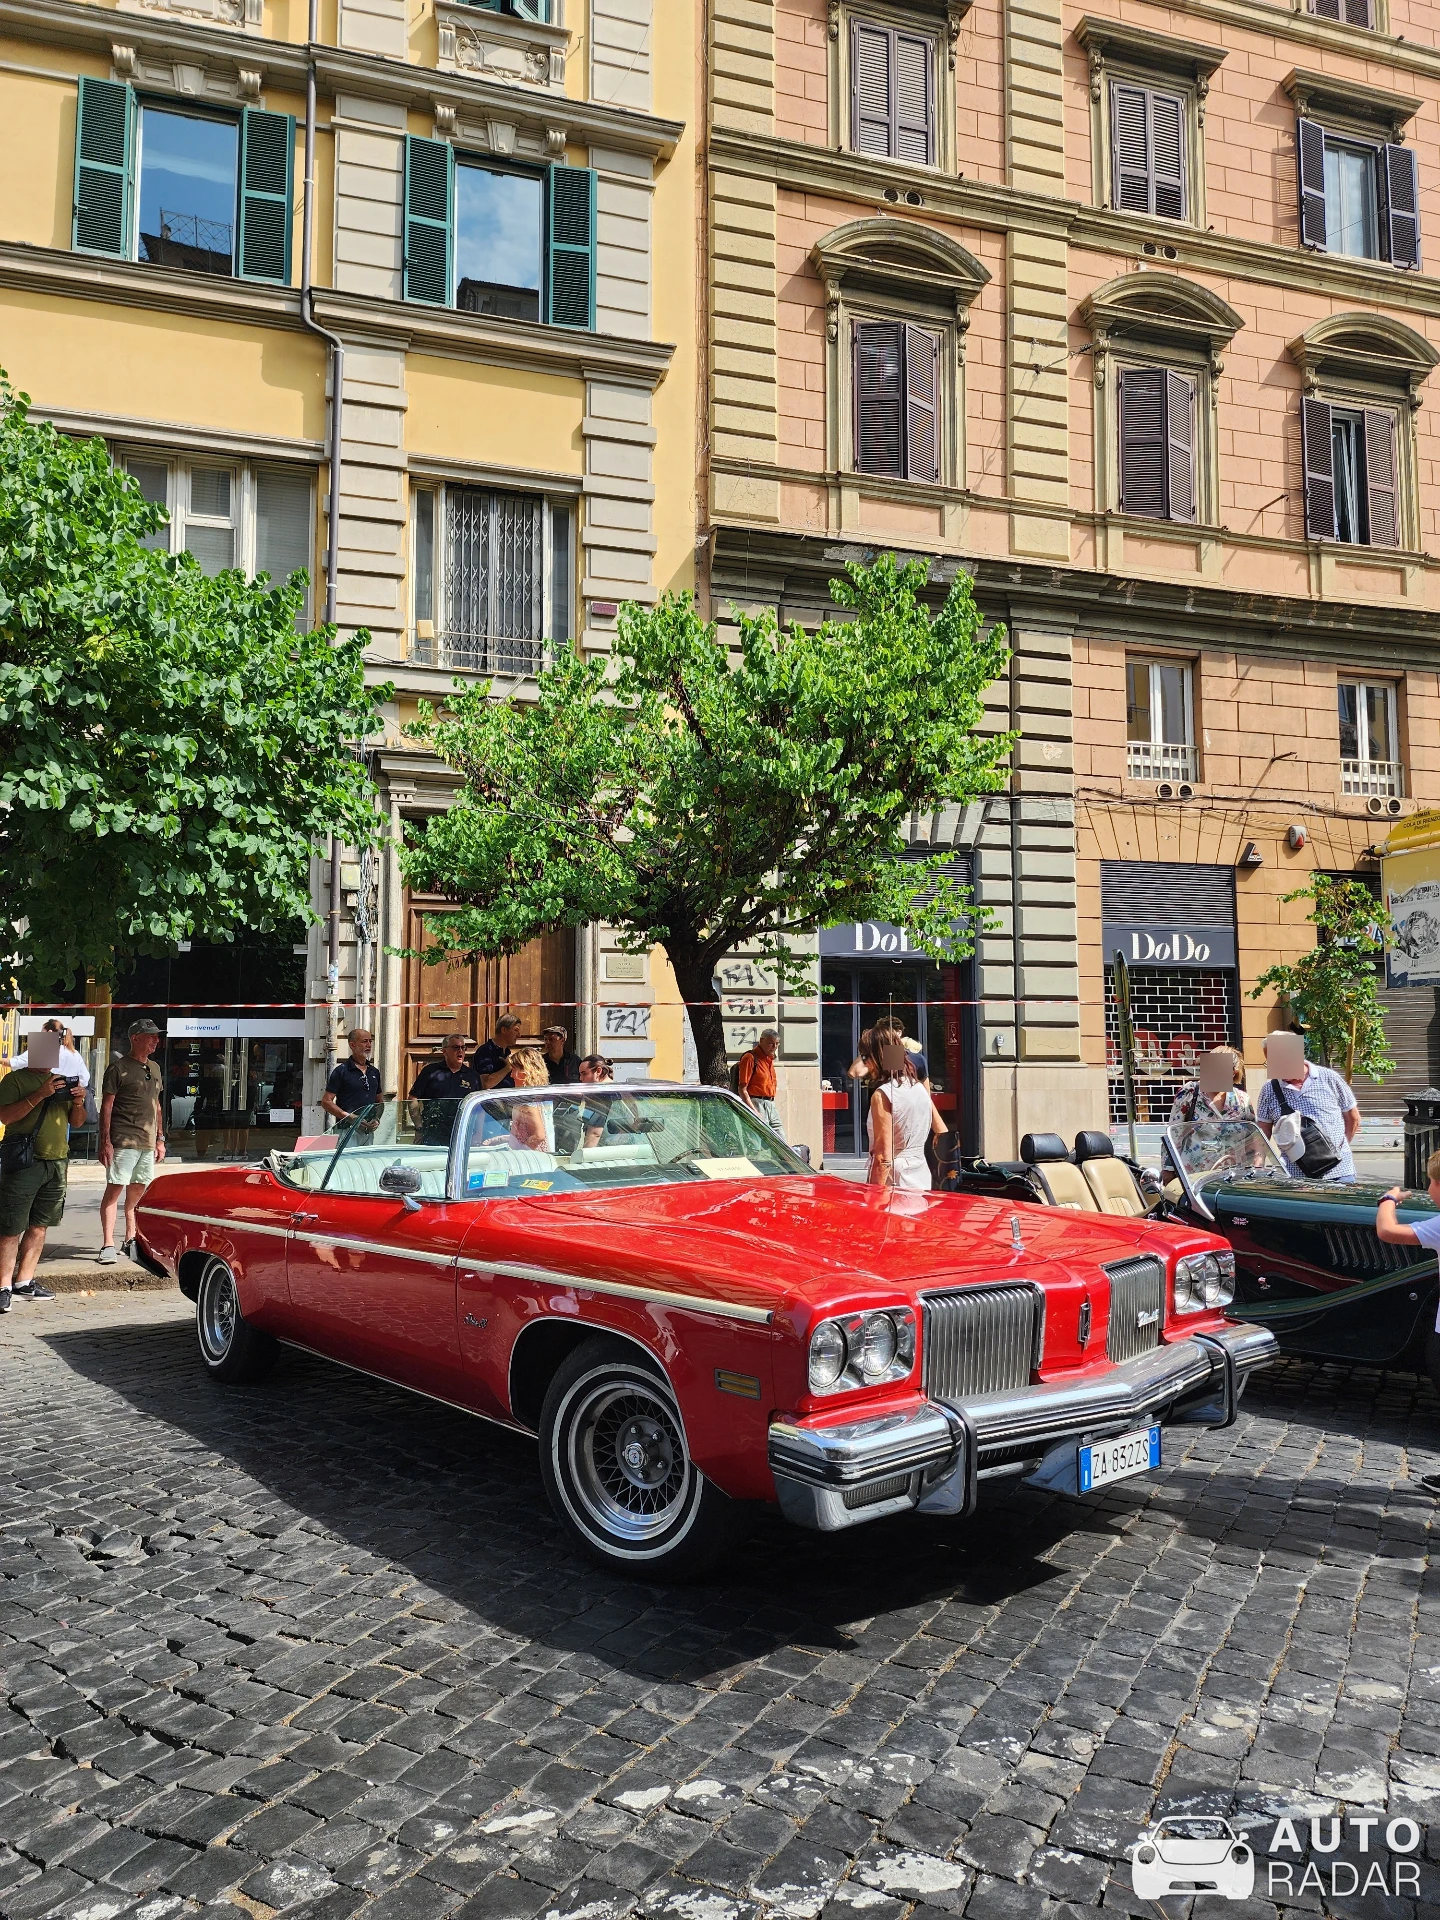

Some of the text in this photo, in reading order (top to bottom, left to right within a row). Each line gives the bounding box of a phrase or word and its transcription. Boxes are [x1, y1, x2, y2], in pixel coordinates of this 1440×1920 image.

[1130, 932, 1210, 962] DoDo
[1093, 1438, 1149, 1479] ZA 832ZS
